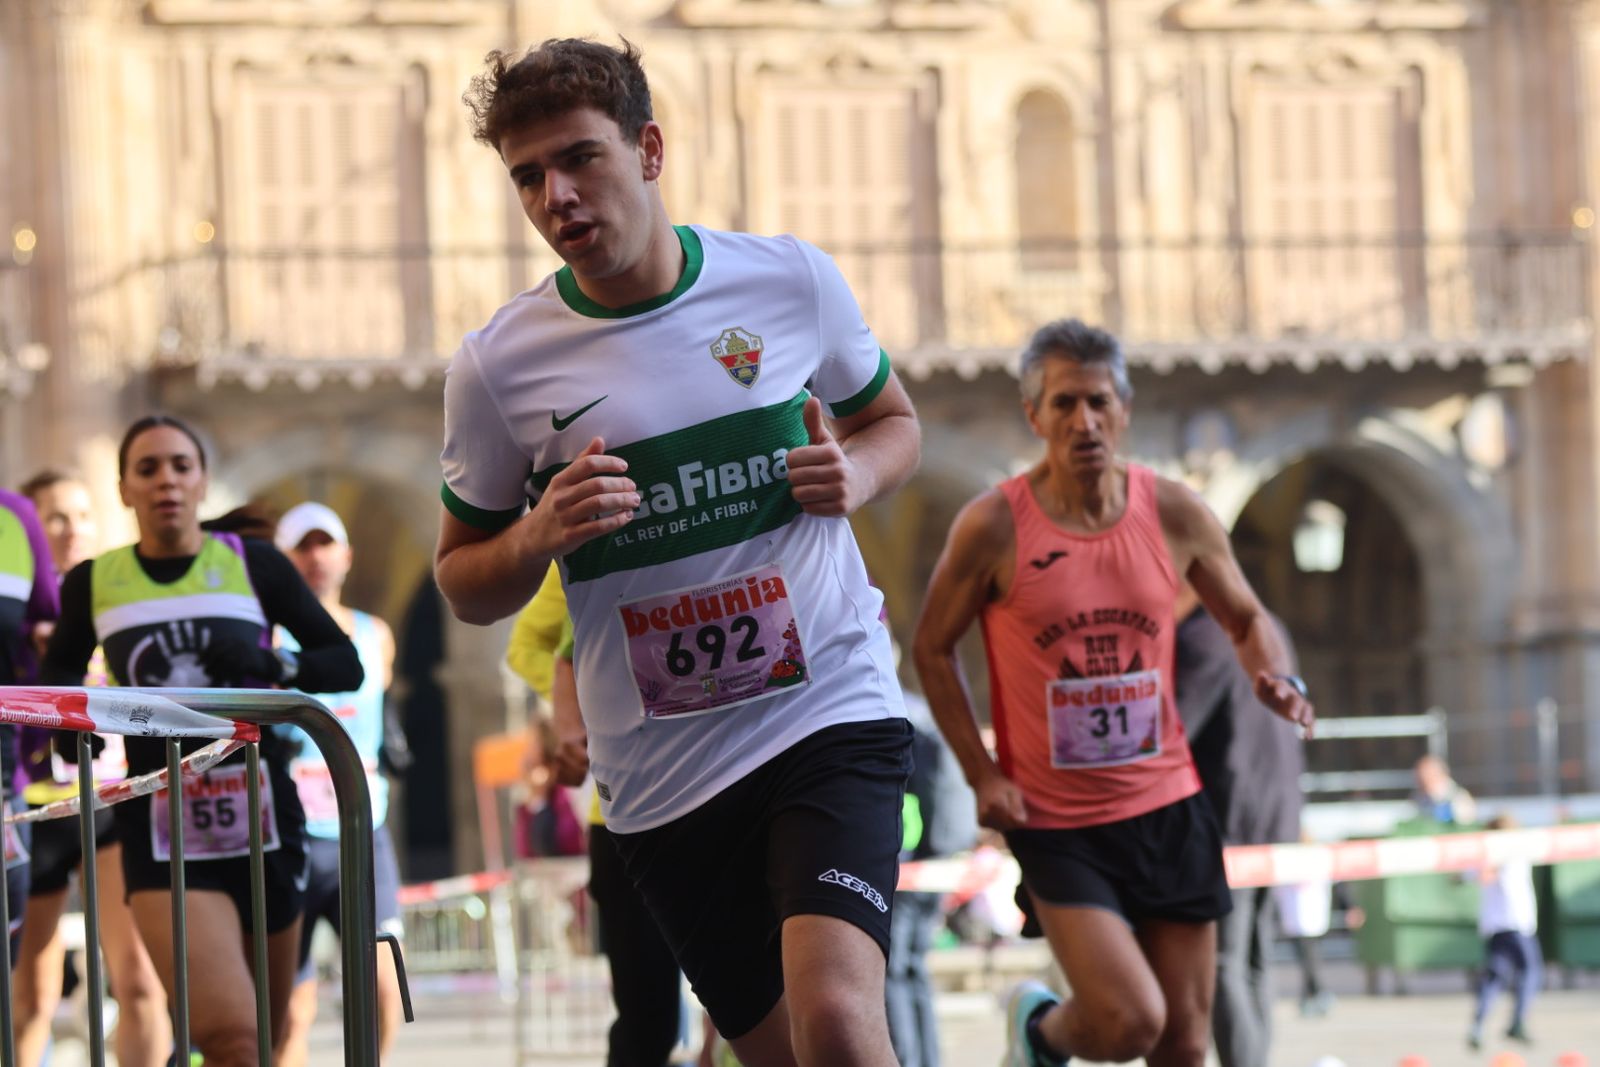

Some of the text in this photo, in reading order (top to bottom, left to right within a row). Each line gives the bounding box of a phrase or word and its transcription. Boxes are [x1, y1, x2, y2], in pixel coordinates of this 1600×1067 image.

[614, 499, 758, 547] EL REY DE LA FIBRA
[619, 576, 788, 638] bedunia
[1066, 612, 1088, 632] LA
[666, 615, 766, 676] 692
[1084, 634, 1118, 655] RUN
[1086, 656, 1120, 677] CLUB
[1052, 681, 1157, 708] bedunia
[0, 706, 63, 726] Ayuntamiento
[1090, 705, 1128, 738] 31
[191, 798, 236, 831] 55
